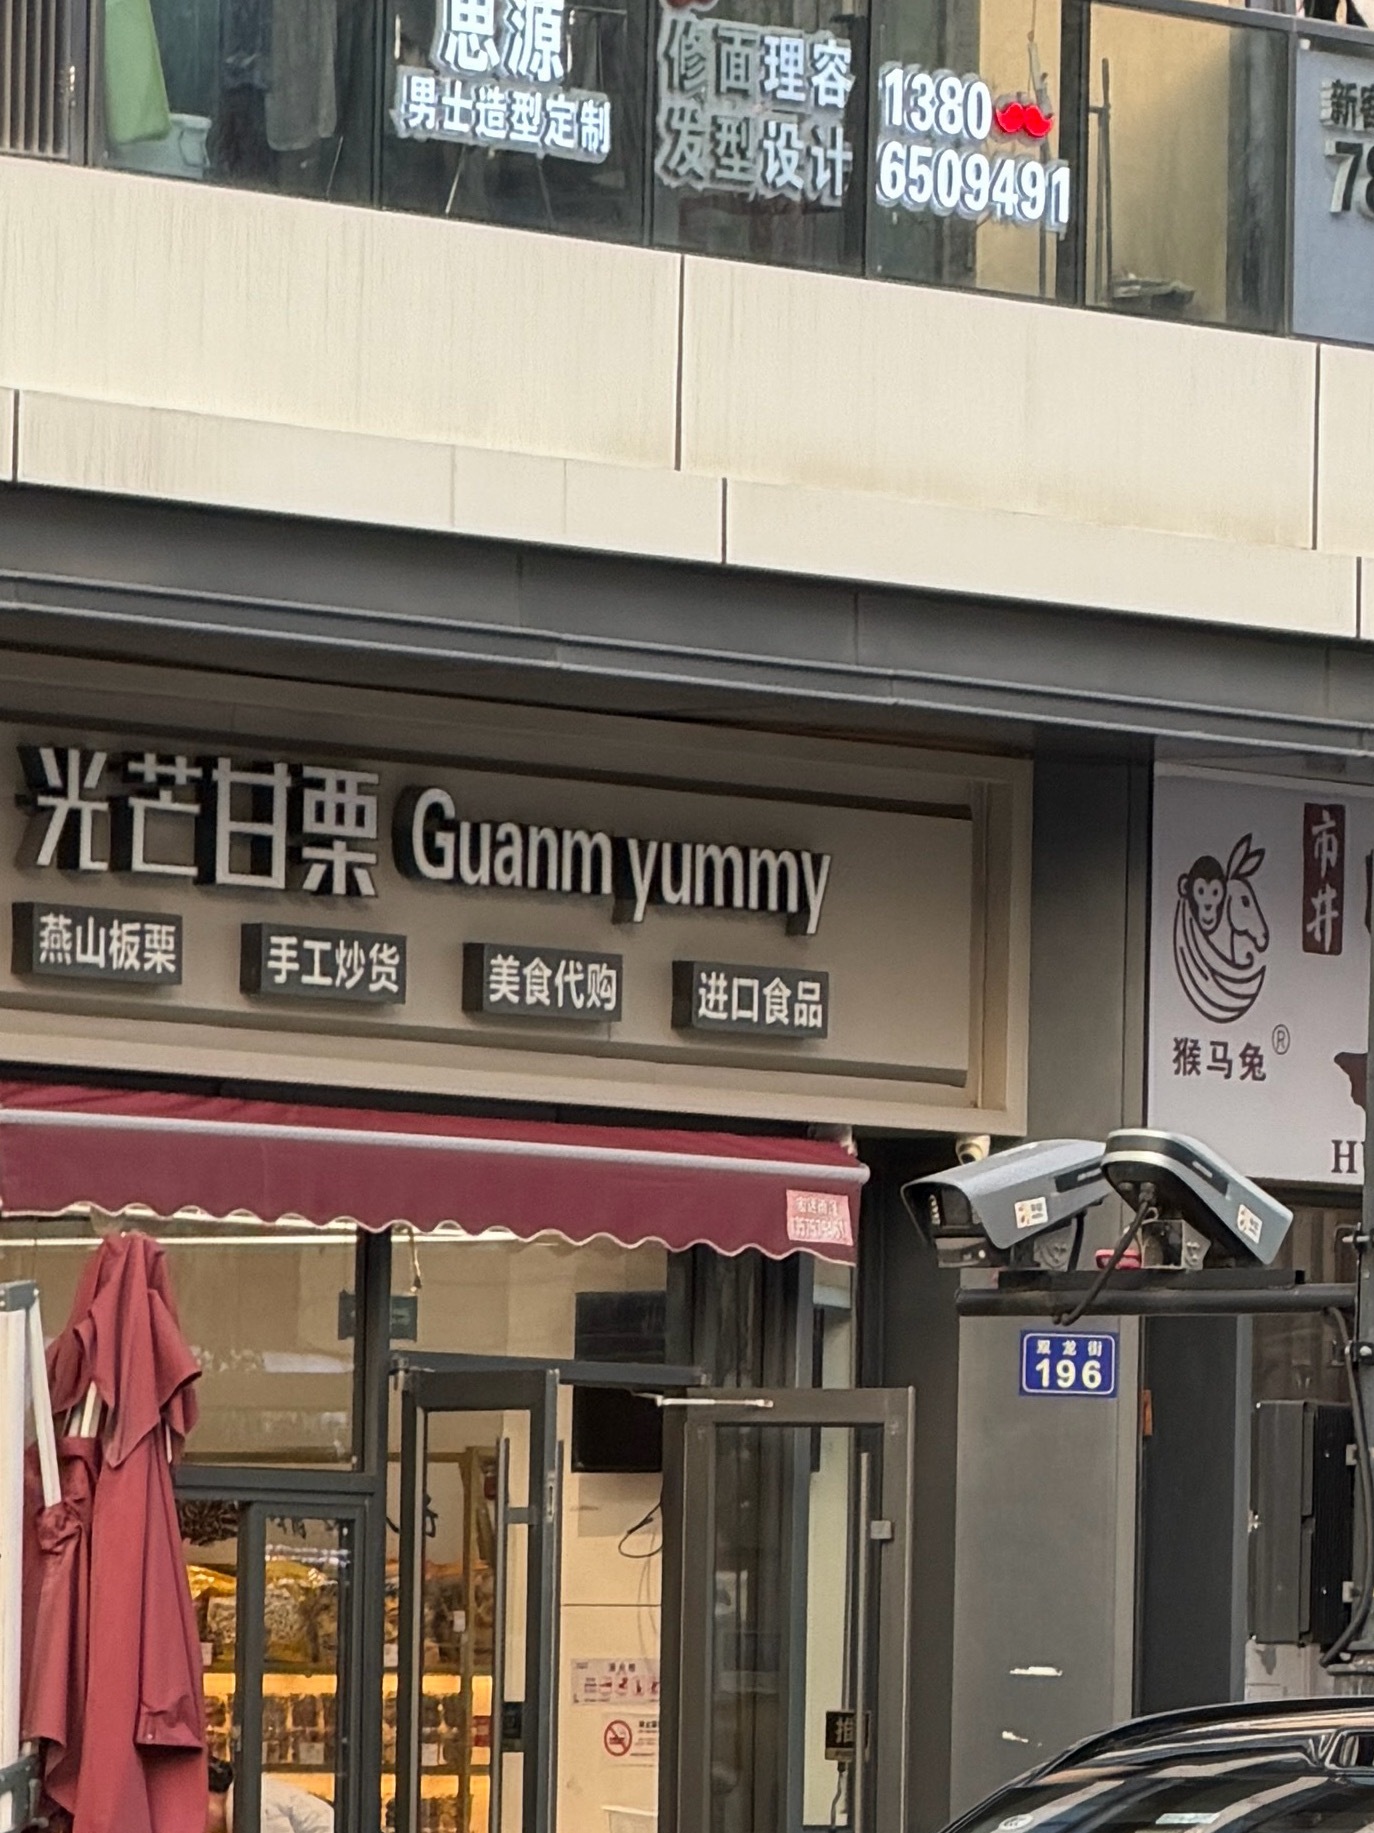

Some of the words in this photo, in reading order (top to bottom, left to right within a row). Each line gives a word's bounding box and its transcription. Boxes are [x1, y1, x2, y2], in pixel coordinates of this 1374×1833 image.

[668, 23, 852, 107] 修面理容
[403, 77, 610, 153] 男士造型定制
[884, 69, 992, 139] 1380
[670, 112, 848, 196] 发型设计
[879, 143, 1070, 224] 6509491
[36, 747, 379, 896] 光芒甘栗
[412, 788, 612, 895] Guanm
[626, 837, 831, 934] yummy
[1306, 810, 1342, 952] 市井
[39, 912, 177, 974] 燕山板栗
[267, 935, 400, 993] 手工炒货
[489, 954, 617, 1011] 美食代购
[698, 971, 823, 1028] 进口食品
[1172, 1036, 1267, 1082] 猴马兔
[1035, 1358, 1103, 1389] 196
